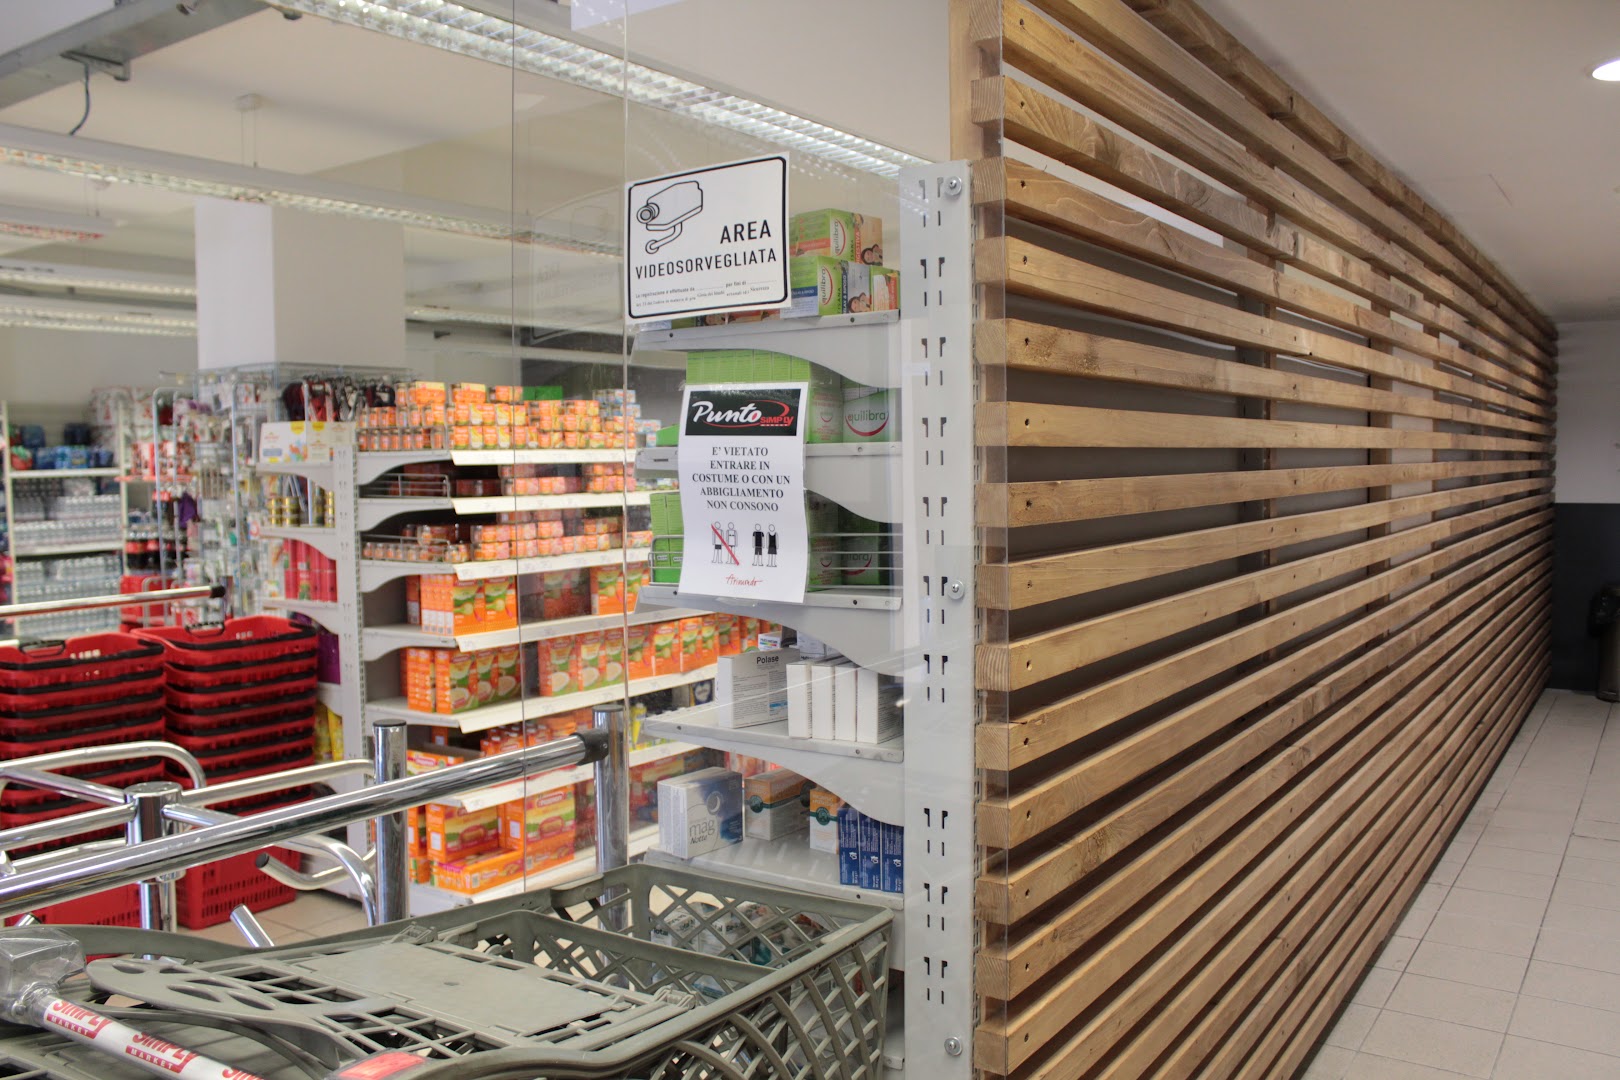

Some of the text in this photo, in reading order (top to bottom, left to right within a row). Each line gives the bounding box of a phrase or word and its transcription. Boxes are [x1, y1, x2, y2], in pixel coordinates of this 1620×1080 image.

[720, 219, 772, 245] AREA
[635, 248, 777, 280] VIDEOSORVEGLIATA
[691, 400, 762, 423] Punto
[846, 410, 886, 424] equilibra
[723, 446, 768, 456] VIETATO
[710, 460, 770, 470] ENTRARE IN
[692, 473, 791, 485] COSTUME O CON UN
[700, 487, 784, 499] ABBIGLIAMENTO
[706, 500, 779, 512] NON CONSONO
[756, 655, 779, 664] Polase
[689, 820, 715, 836] mag
[690, 835, 708, 844] Notte
[53, 1000, 112, 1034] SIMPLY
[51, 1015, 89, 1036] MARKET
[132, 1031, 200, 1068] SIMPLY
[130, 1047, 173, 1070] MARKET
